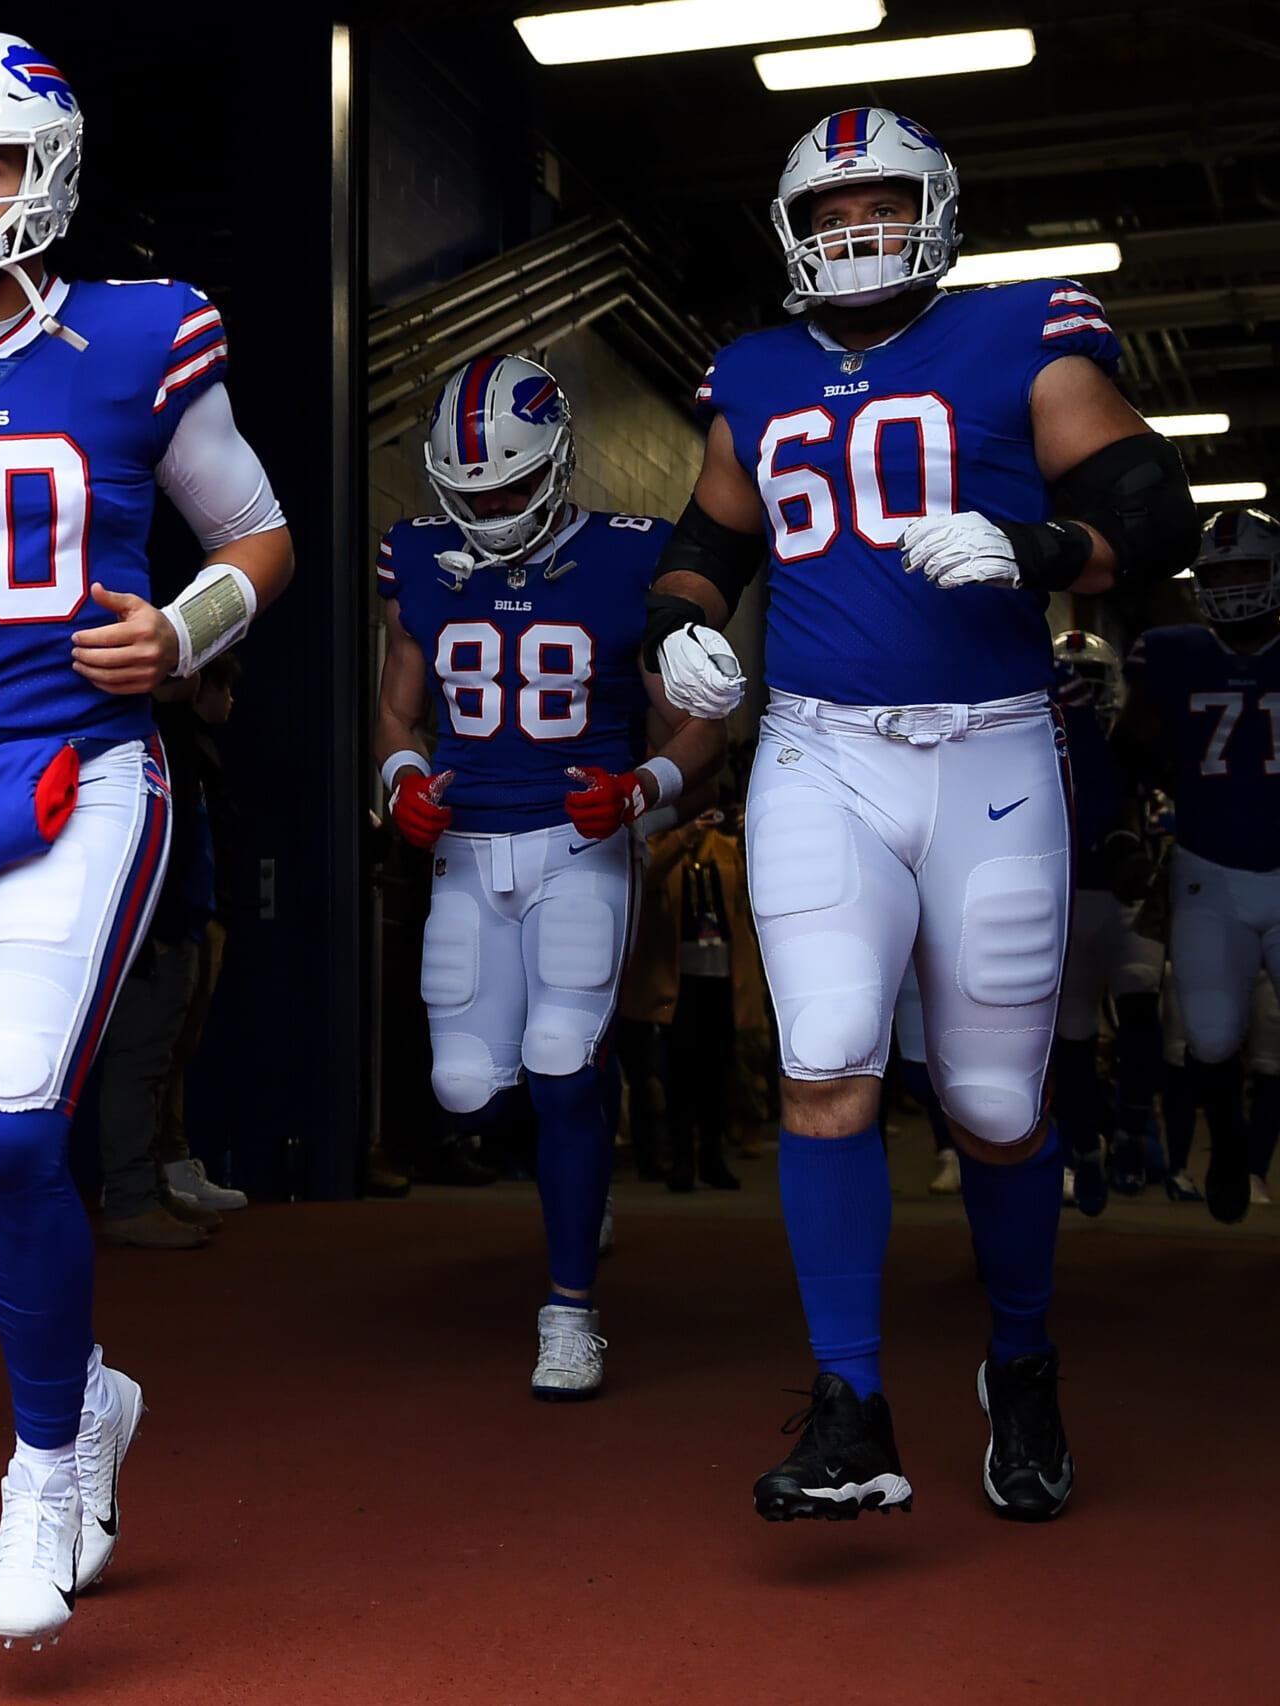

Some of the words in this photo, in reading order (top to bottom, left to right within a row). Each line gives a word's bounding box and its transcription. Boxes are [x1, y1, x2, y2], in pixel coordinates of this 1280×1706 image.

[823, 381, 870, 397] BILLS
[757, 390, 958, 566] 60
[494, 600, 532, 611] BILLS
[435, 619, 596, 742] 88
